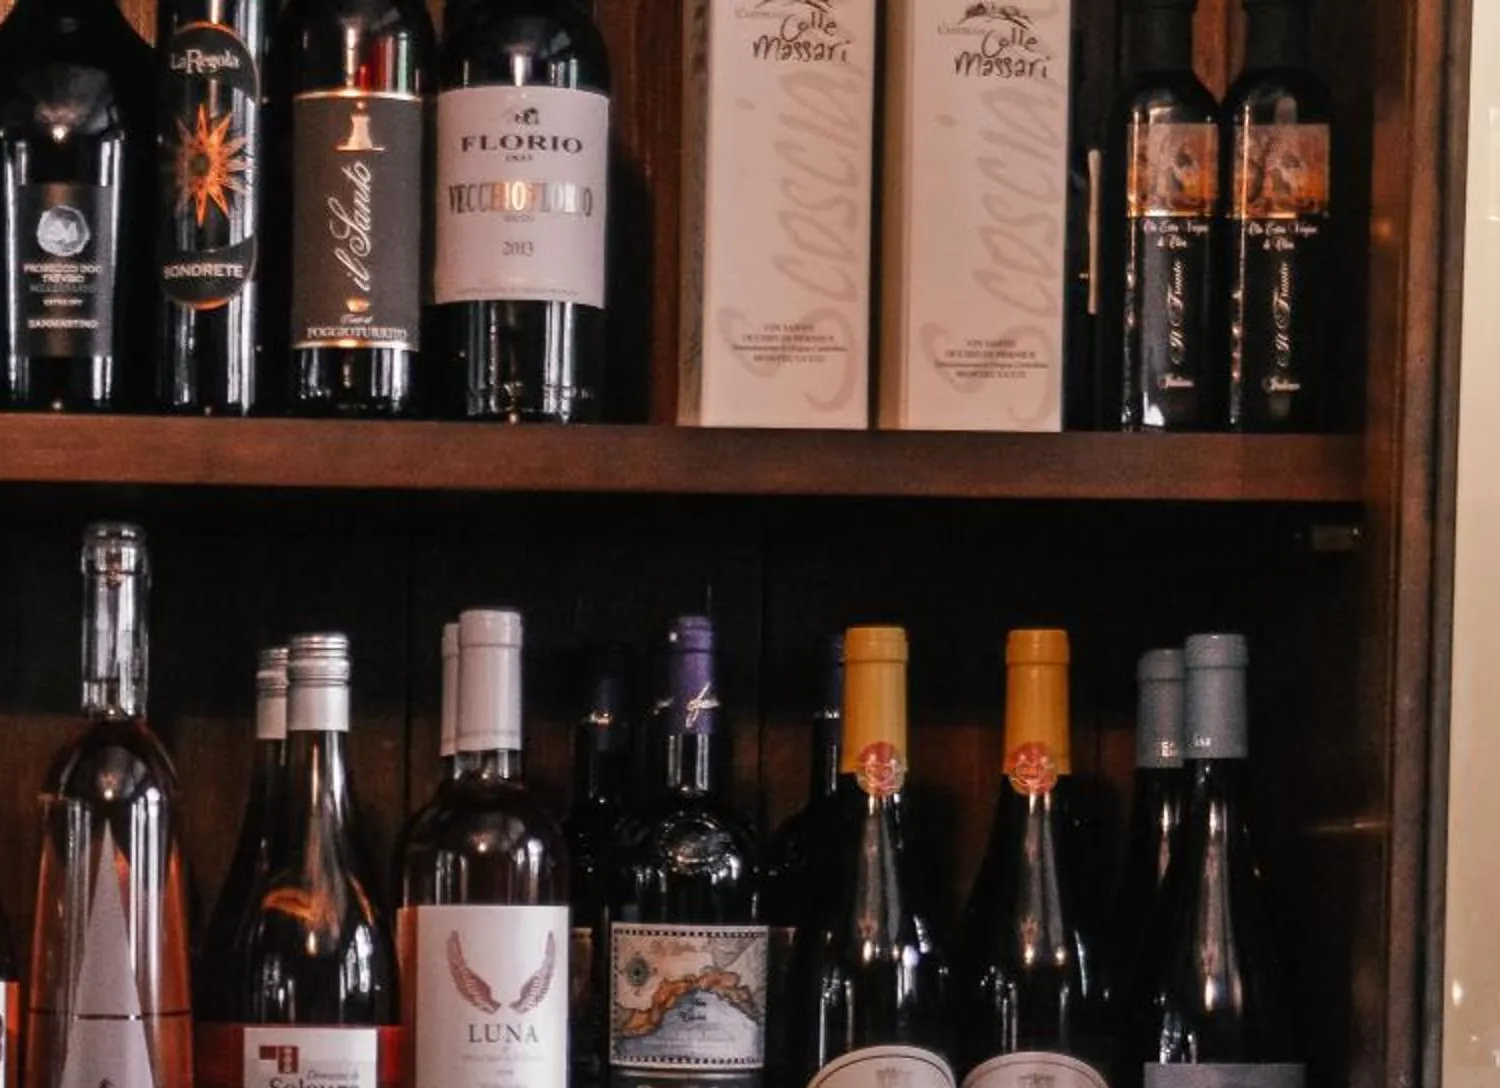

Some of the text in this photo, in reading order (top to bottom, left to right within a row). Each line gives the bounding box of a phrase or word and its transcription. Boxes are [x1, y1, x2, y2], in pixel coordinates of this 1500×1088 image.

[753, 34, 851, 62] Massari
[954, 50, 1051, 79] Massari
[461, 134, 583, 153] FLORIO
[327, 161, 372, 257] Santo
[468, 1023, 539, 1043] LUNA
